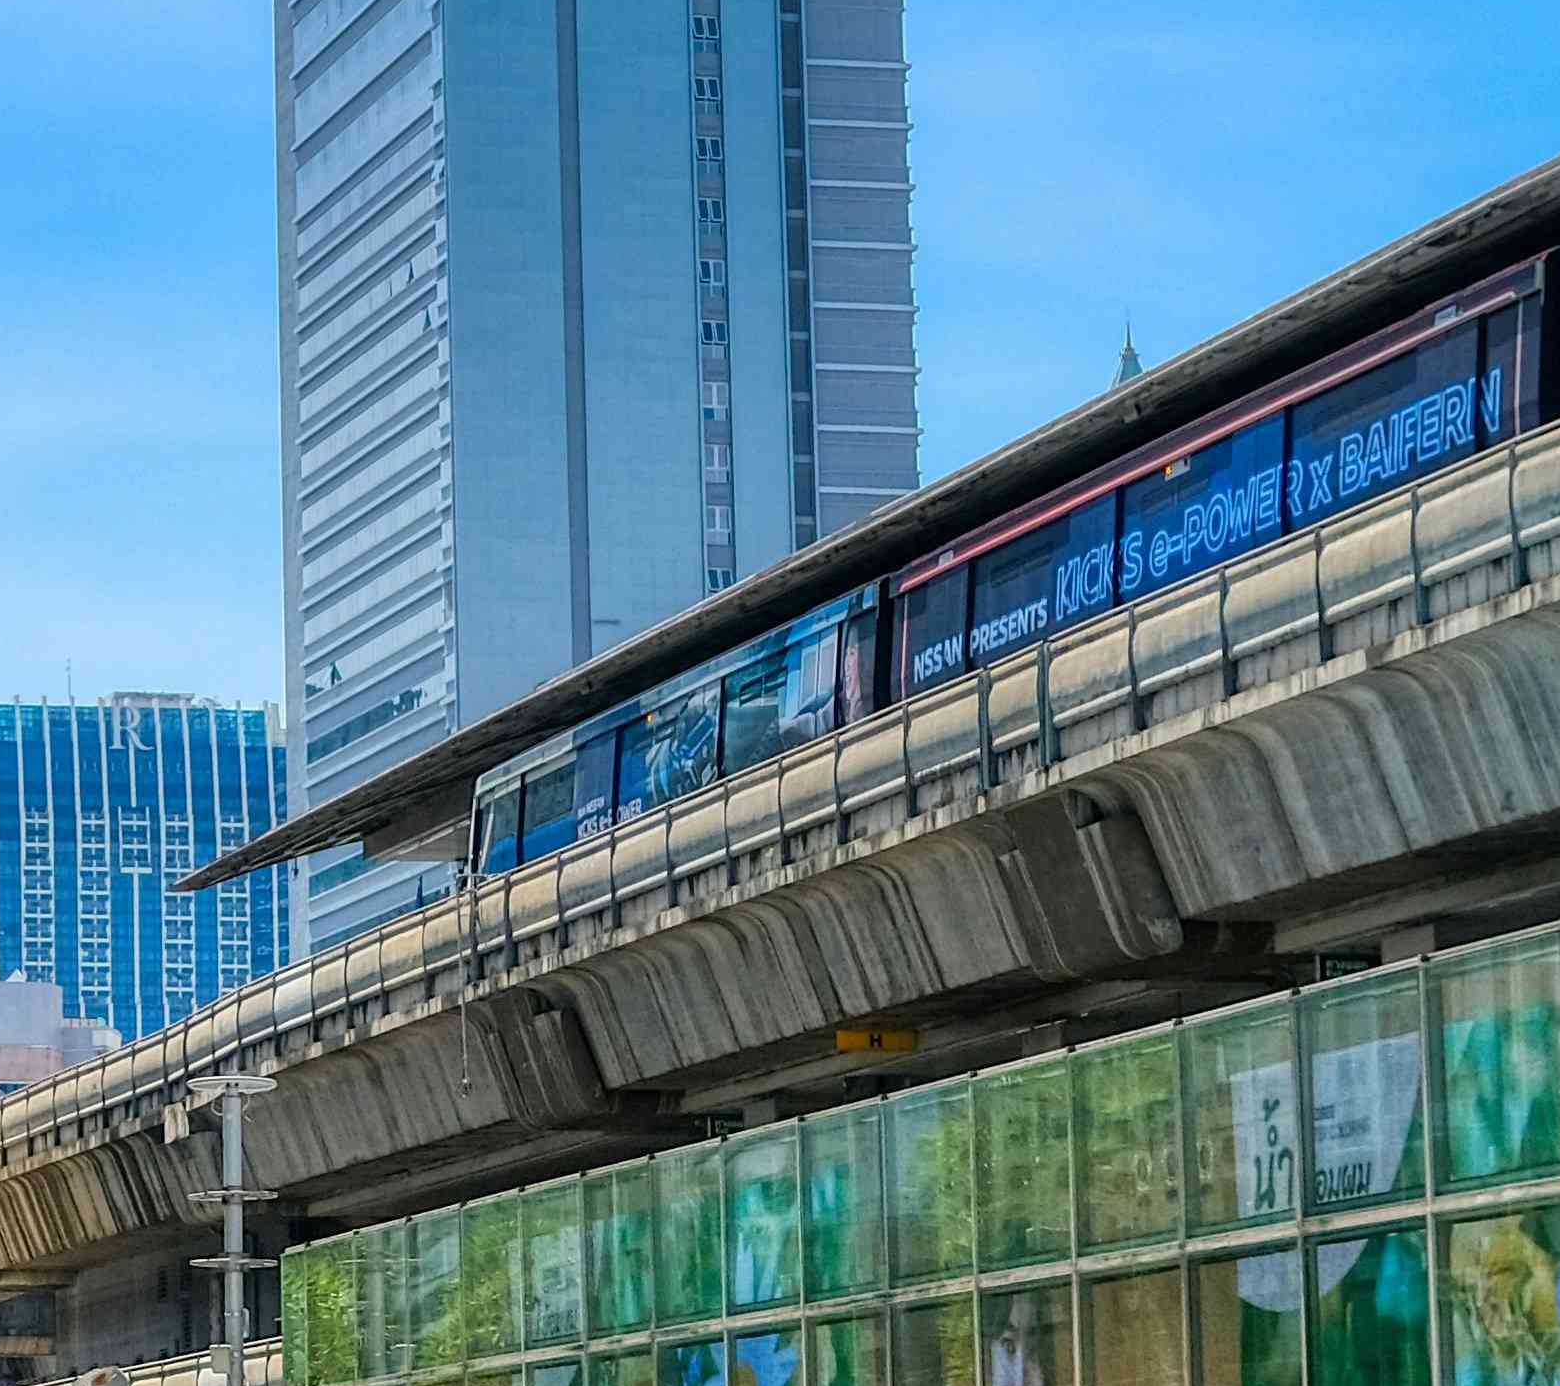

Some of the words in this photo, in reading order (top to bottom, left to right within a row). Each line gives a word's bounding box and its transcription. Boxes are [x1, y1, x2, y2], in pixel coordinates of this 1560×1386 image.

[914, 633, 963, 684] NSSAN
[970, 597, 1048, 658] PRESENTS
[1056, 530, 1143, 621] KICKS
[1149, 460, 1304, 577] e-POWER
[1339, 369, 1501, 496] BAIFERN
